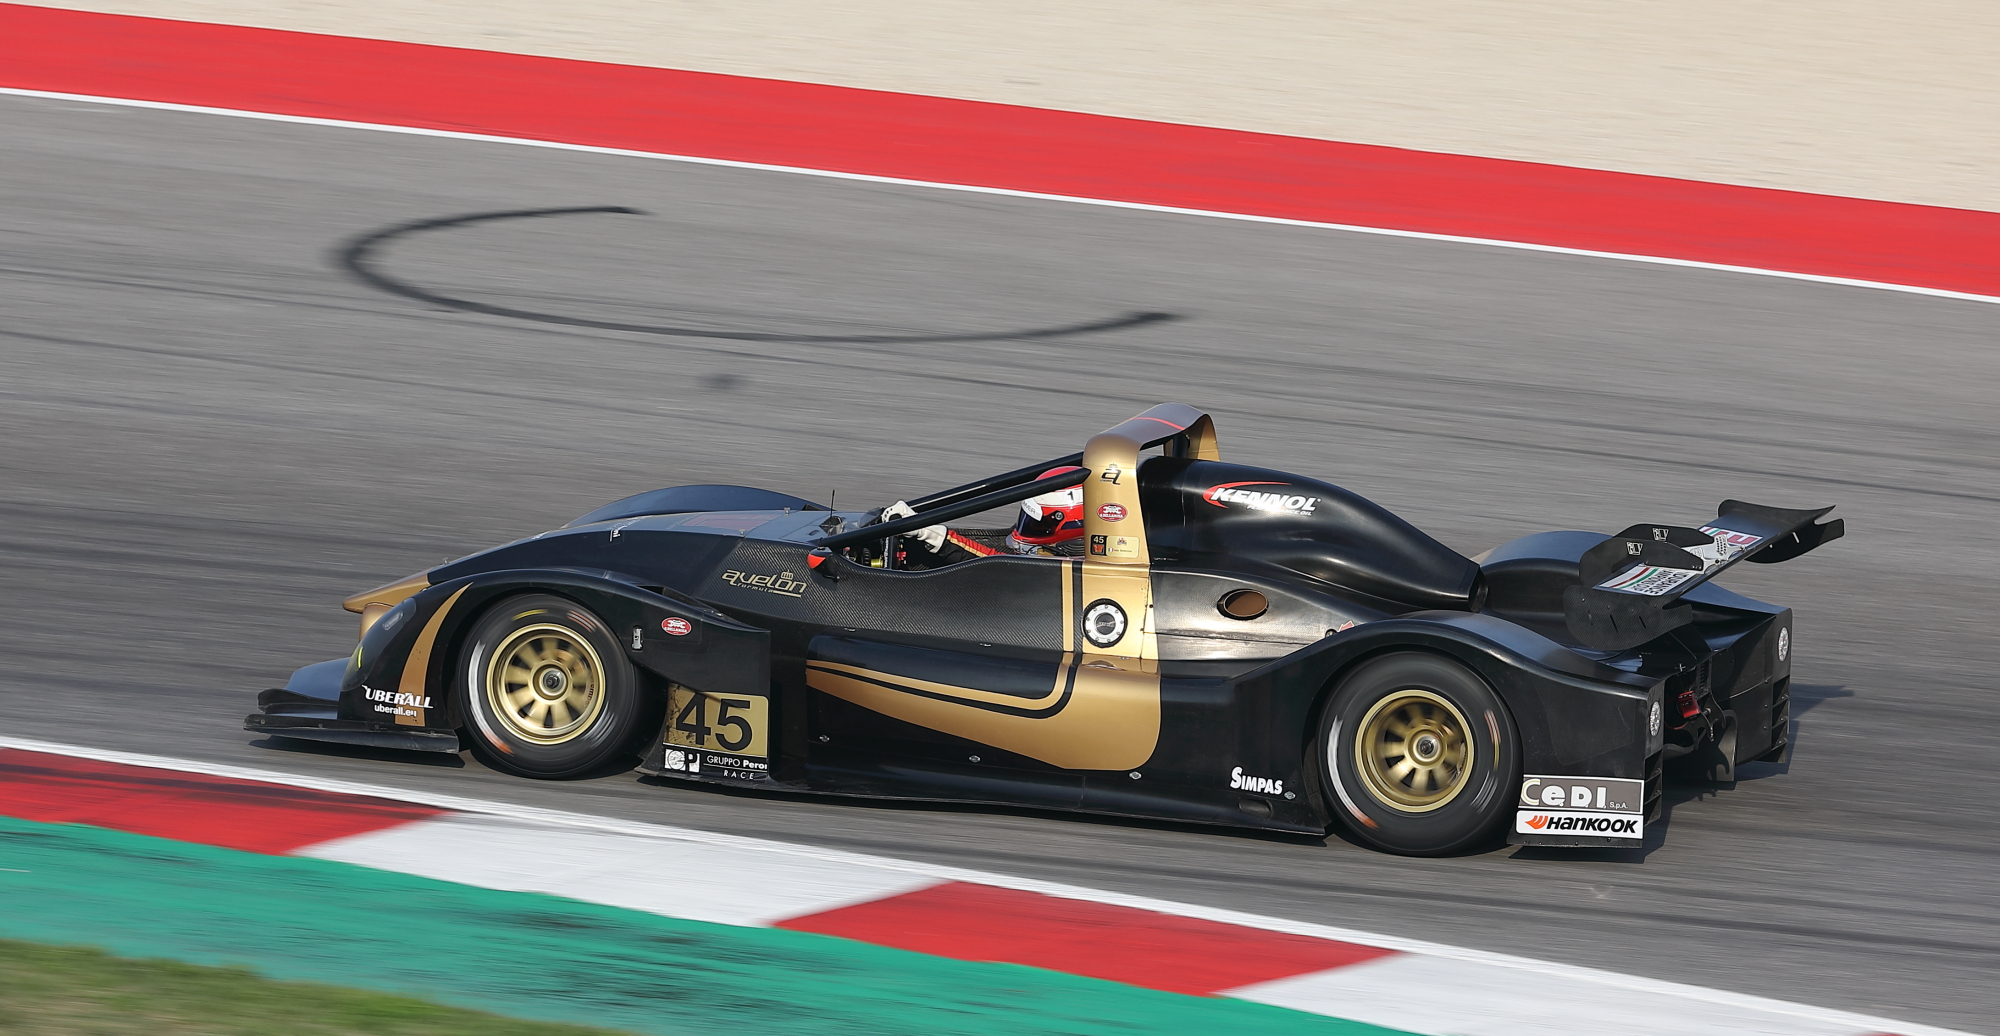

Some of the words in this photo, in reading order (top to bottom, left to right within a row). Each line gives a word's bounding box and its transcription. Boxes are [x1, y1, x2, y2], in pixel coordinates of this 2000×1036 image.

[1211, 487, 1317, 511] KENNOL
[1093, 536, 1104, 544] 45
[722, 570, 807, 593] avelon
[362, 685, 434, 709] UBERALL
[676, 692, 753, 752] 45
[706, 755, 741, 767] GRUPPO
[1609, 801, 1629, 810] S.p.A.
